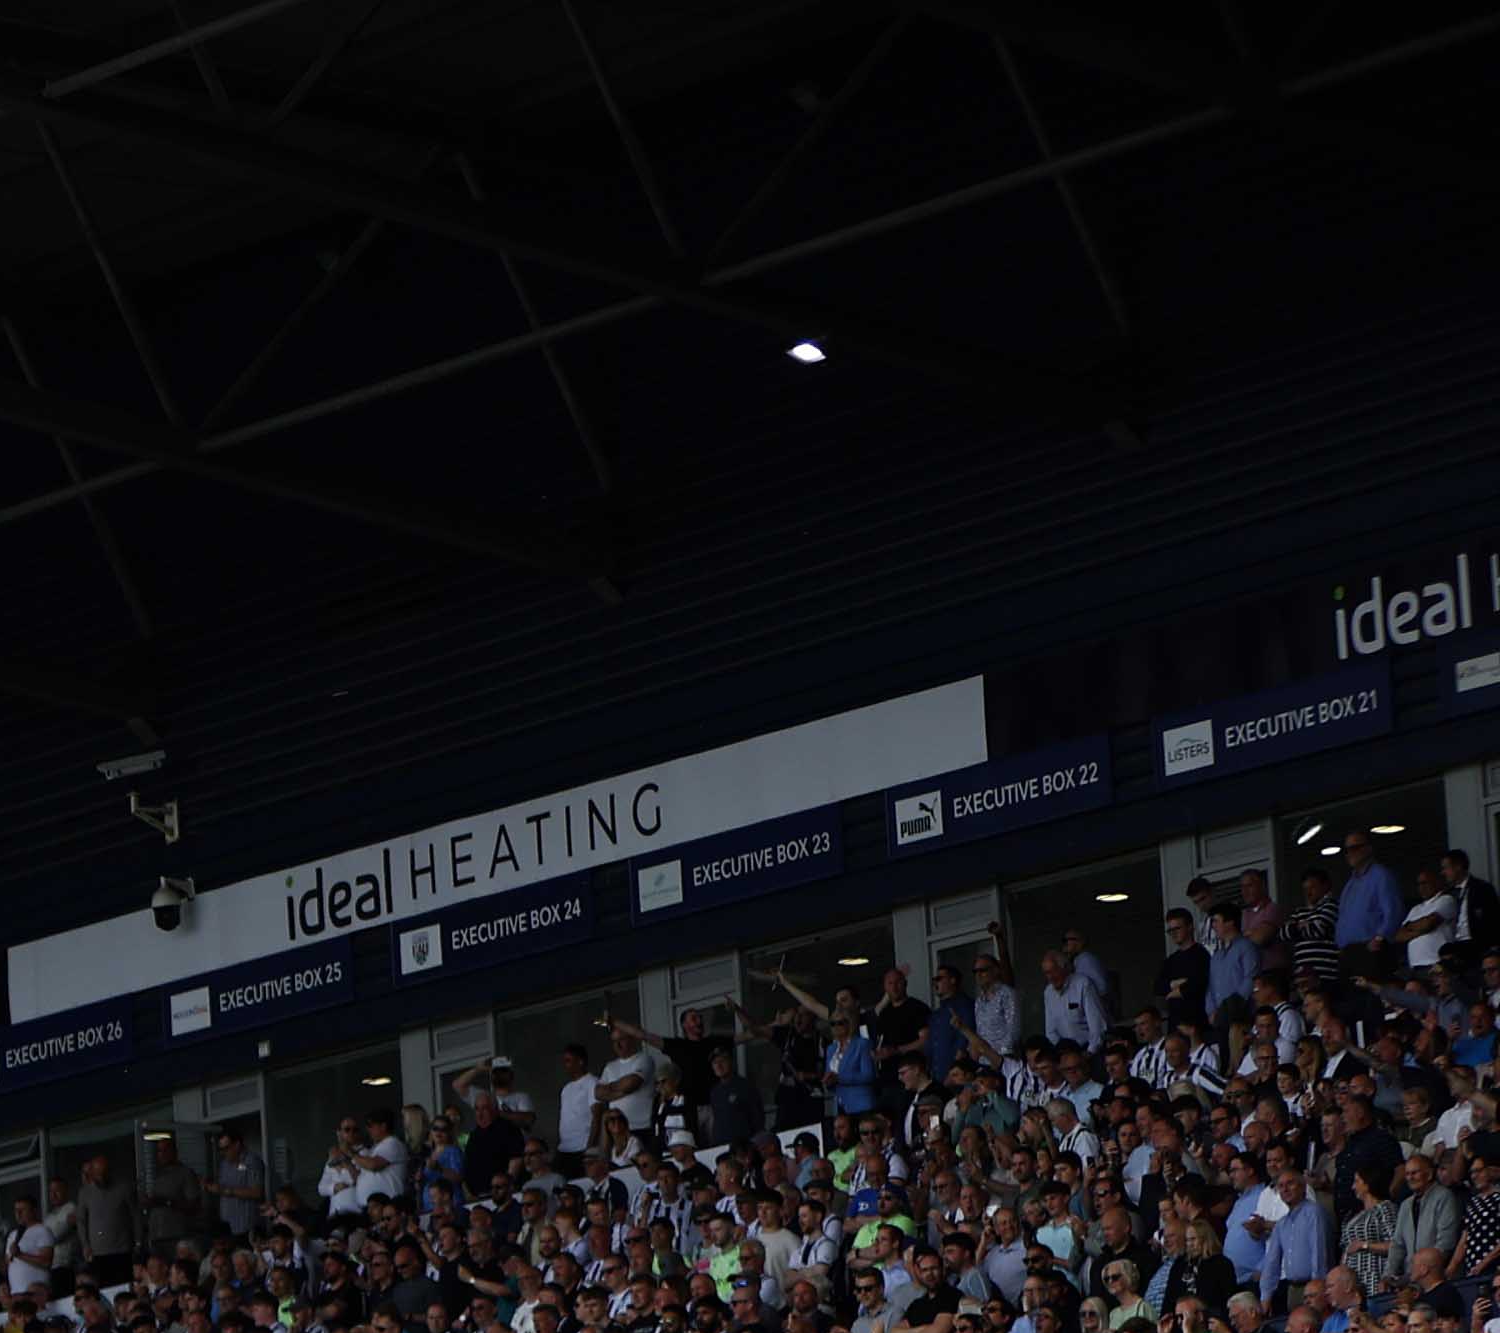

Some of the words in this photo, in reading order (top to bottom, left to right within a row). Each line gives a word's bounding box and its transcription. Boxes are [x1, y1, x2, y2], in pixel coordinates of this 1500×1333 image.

[1334, 553, 1472, 660] ideal
[1225, 707, 1315, 748] EXECUTIVE
[1318, 695, 1355, 724] BOX
[1358, 688, 1378, 712] 21
[1167, 742, 1210, 763] LISTERS
[953, 778, 1039, 818] EXECUTIVE
[1042, 768, 1076, 796] BOX
[1078, 762, 1099, 784] 22
[900, 815, 931, 838] PUMA
[284, 849, 393, 941] ideal
[409, 781, 663, 901] HEATING
[693, 847, 773, 887] EXECUTIVE
[777, 836, 810, 864] BOX
[812, 832, 831, 854] 23
[451, 912, 528, 950] EXECUTIVE
[530, 903, 562, 929] BOX
[564, 897, 581, 920] 24
[219, 976, 292, 1012] EXECUTIVE
[295, 966, 323, 993] BOX
[326, 961, 342, 985] 25
[6, 1033, 75, 1069] EXECUTIVE
[77, 1024, 104, 1050] BOX
[106, 1020, 123, 1042] 26
